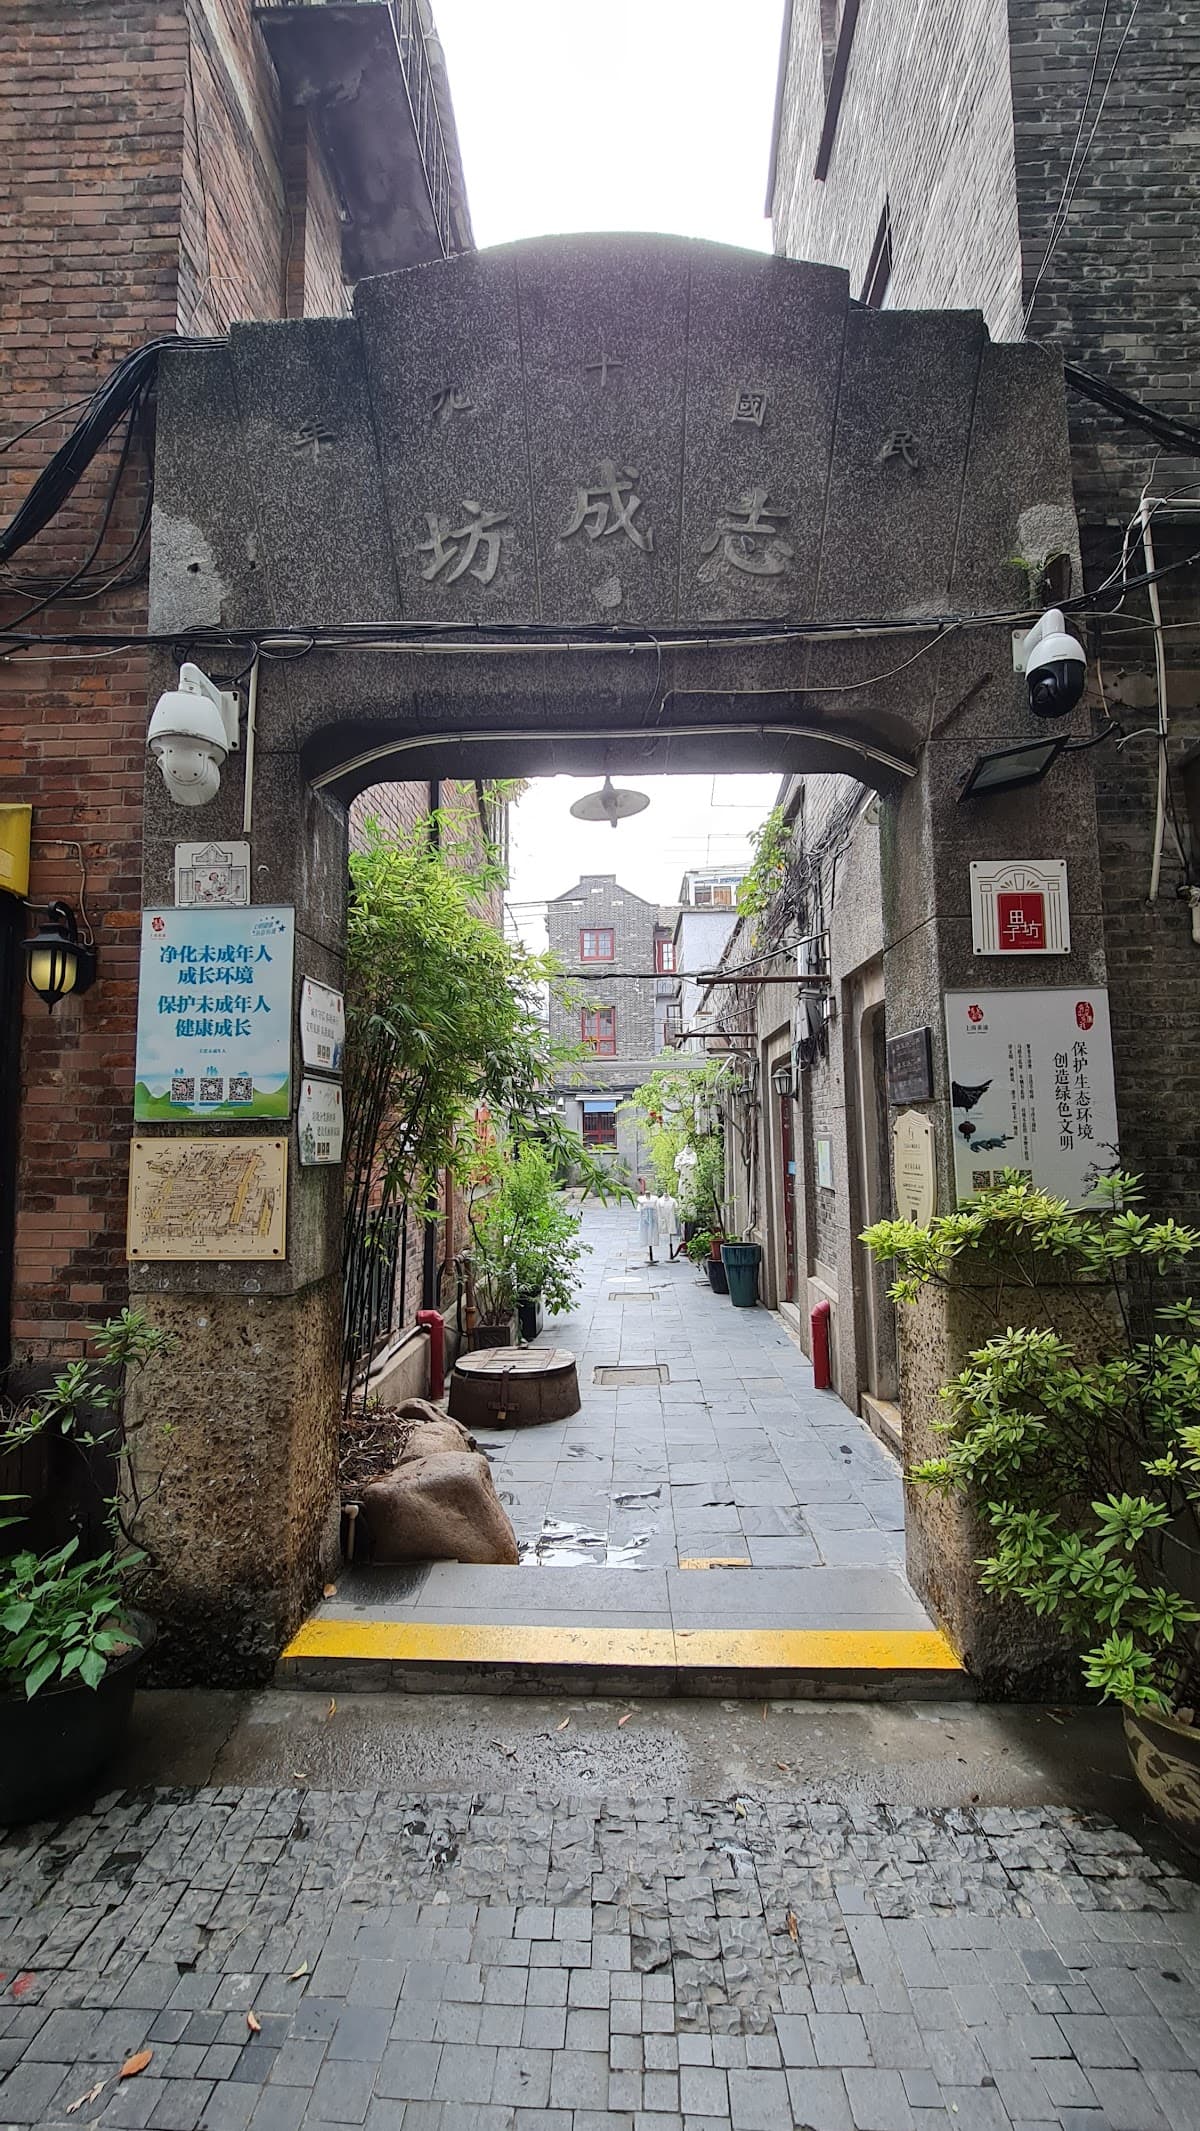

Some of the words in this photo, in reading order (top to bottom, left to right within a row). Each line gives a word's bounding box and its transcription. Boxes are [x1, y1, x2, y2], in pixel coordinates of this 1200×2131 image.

[1002, 910, 1043, 942] 田子坊
[159, 944, 273, 964] 净化未成年人
[177, 965, 254, 985] 成长环境
[157, 994, 272, 1015] 保护未成年人
[175, 1017, 252, 1038] 健康成长
[1071, 1040, 1094, 1140] 保护生态环境
[1053, 1052, 1074, 1152] 创造绿色文明
